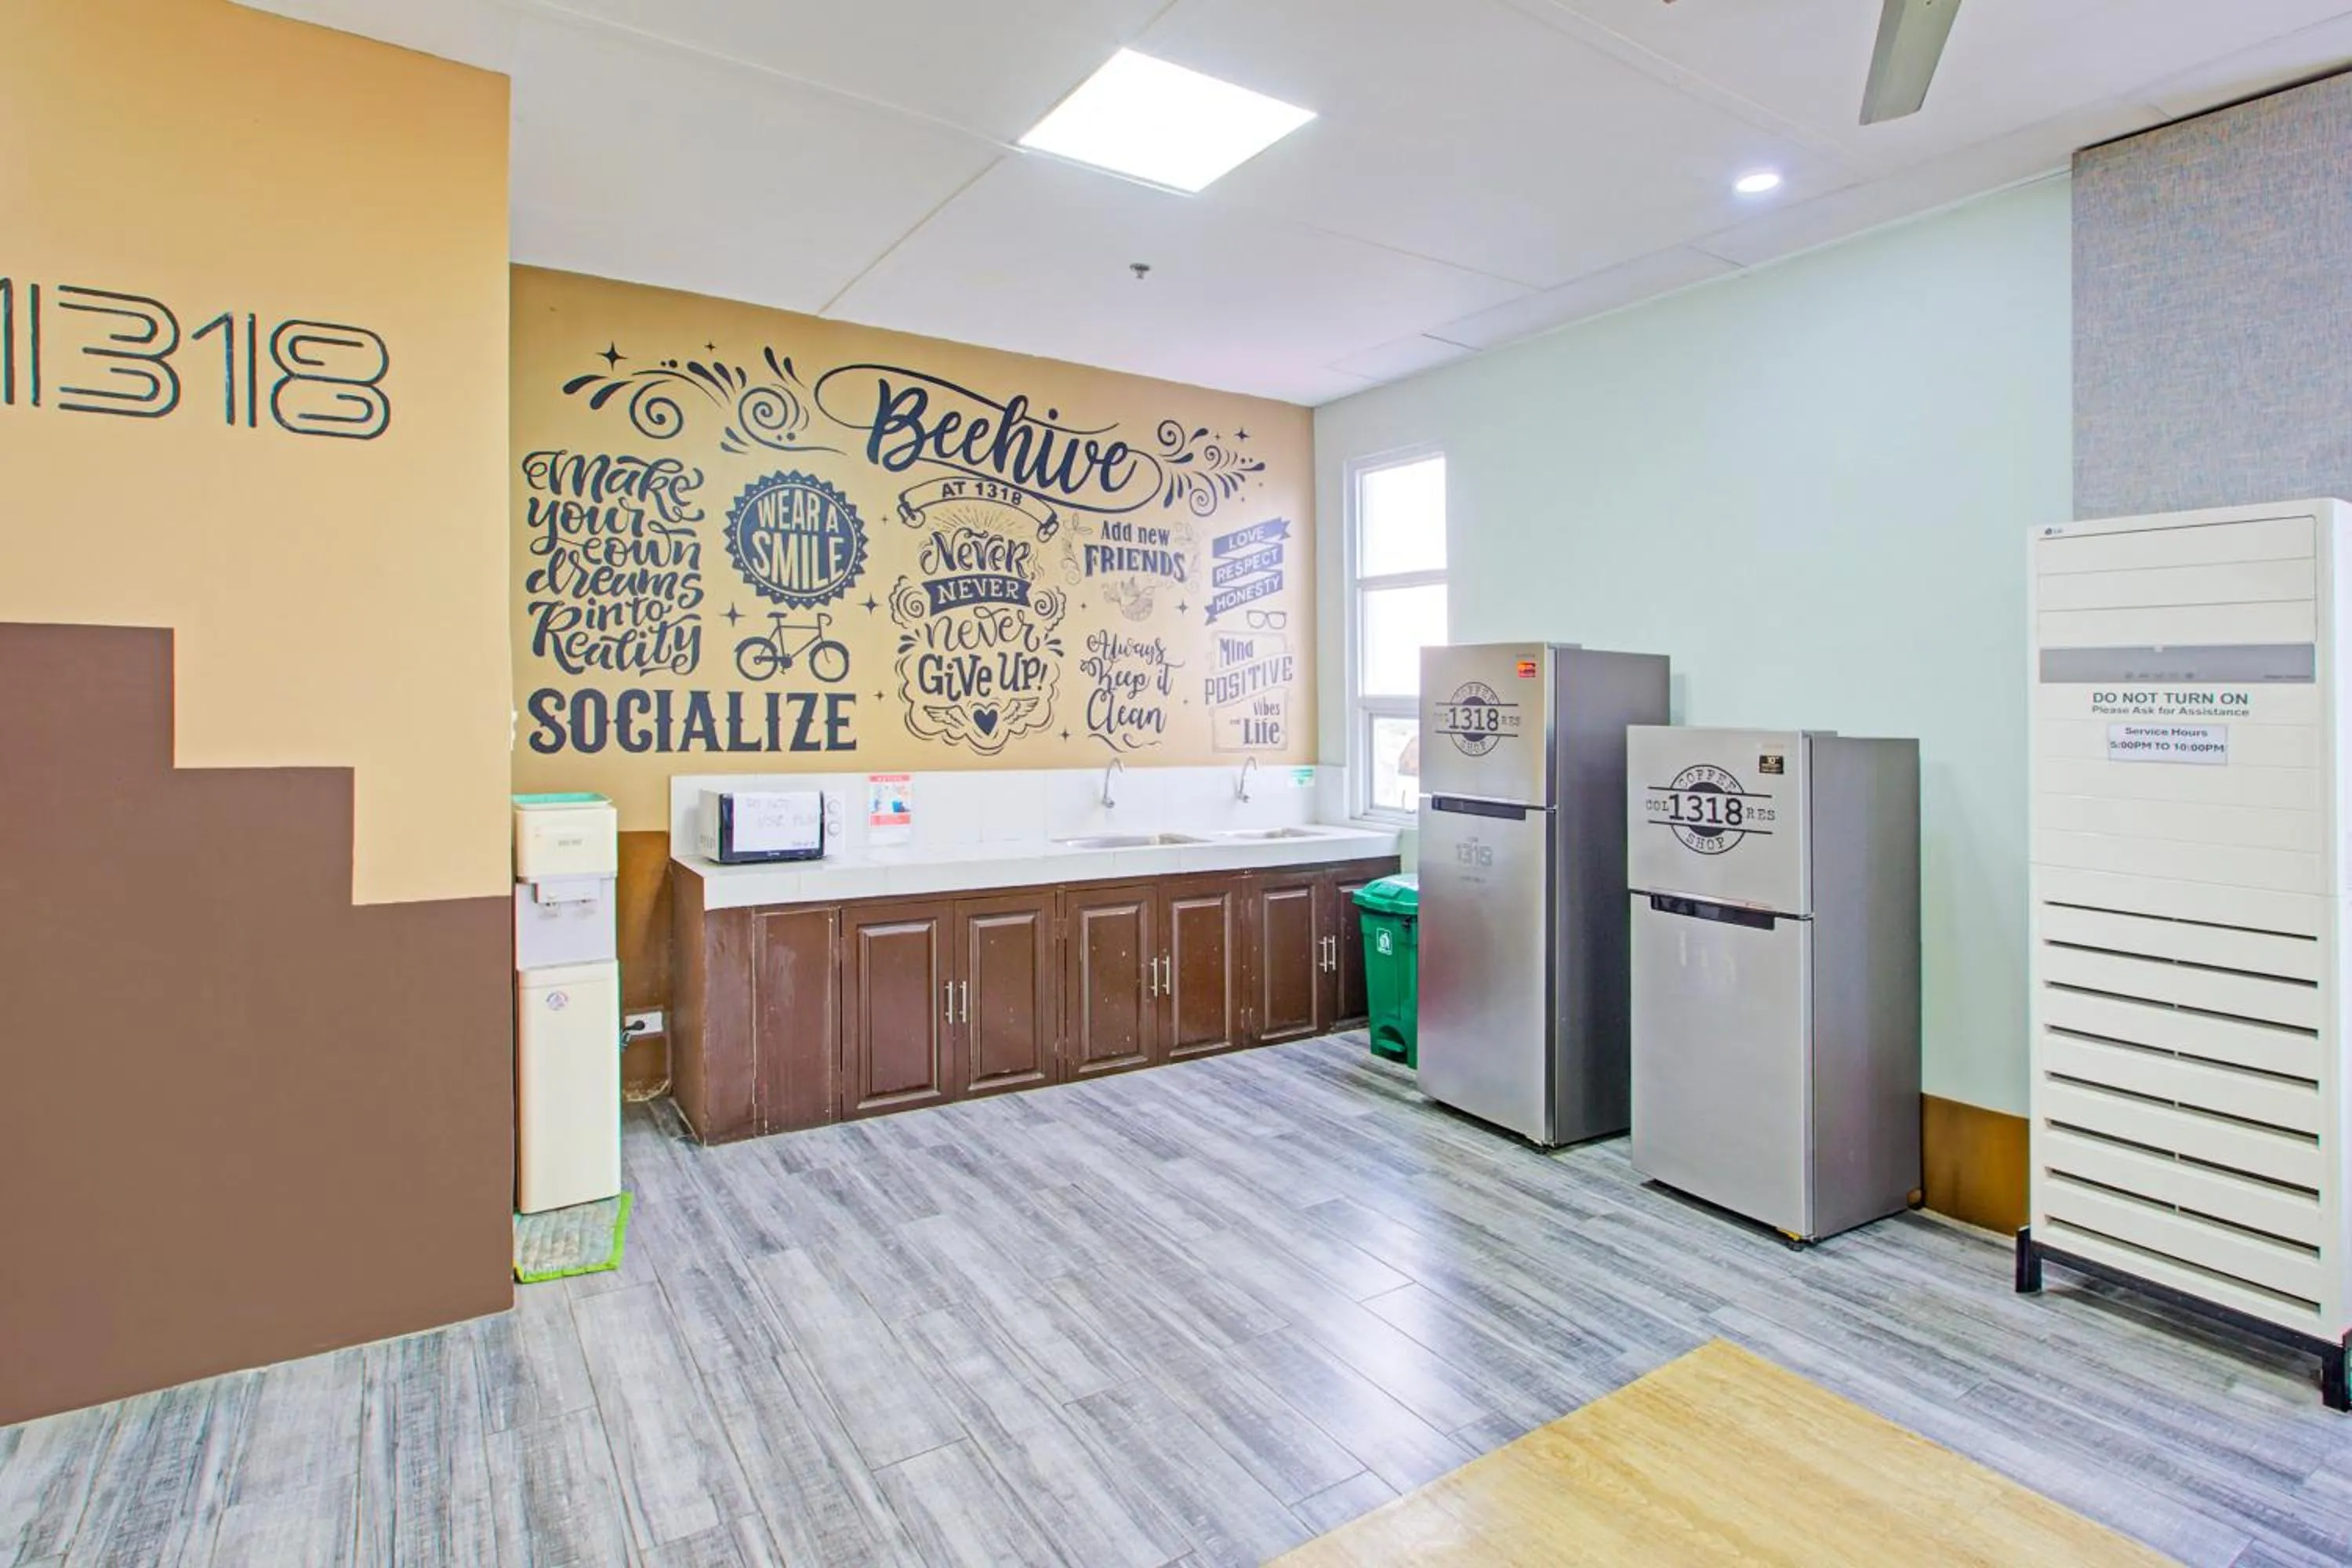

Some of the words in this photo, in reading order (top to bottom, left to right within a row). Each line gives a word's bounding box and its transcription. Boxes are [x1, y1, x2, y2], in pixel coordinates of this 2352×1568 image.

[866, 379, 1137, 494] Beehive
[522, 449, 704, 522] Make
[942, 481, 966, 498] AT
[975, 482, 1022, 506] 1318
[528, 496, 644, 555] your
[757, 489, 819, 531] WEAR
[826, 504, 840, 532] A
[583, 521, 700, 570] own
[1101, 520, 1131, 543] Add
[1138, 526, 1170, 546] new
[1228, 525, 1265, 550] LOVE
[526, 547, 704, 609] dreams
[751, 530, 845, 593] SMILE
[1083, 543, 1187, 583] FRIENDS
[1215, 548, 1279, 584] RESPECT
[937, 577, 1019, 604] NEVER
[1216, 575, 1280, 612] HONESTY
[586, 597, 672, 630] into
[924, 606, 1040, 652] never
[528, 601, 702, 677] Reality
[1087, 629, 1167, 665] Always
[1080, 657, 1150, 700] Keep
[1156, 662, 1174, 696] it
[1204, 655, 1293, 705] POSITIVE
[1087, 688, 1167, 735] Clean
[2092, 692, 2117, 703] DO
[2122, 692, 2158, 703] NOT
[2163, 692, 2214, 704] TURN
[2220, 692, 2249, 705] ON
[2092, 706, 2129, 714] Please
[2132, 706, 2154, 714] Ask
[2158, 706, 2176, 715] for
[2178, 706, 2249, 717] Assistance
[528, 688, 857, 753] SOCIALIZE
[1243, 717, 1280, 745] Life
[1449, 707, 1499, 731] 1318
[2125, 727, 2168, 736] Service
[2171, 728, 2208, 737] Hours
[2110, 741, 2152, 750] 5:00PM
[2155, 742, 2170, 750] TO
[2174, 743, 2224, 753] 10:00PM
[1679, 769, 1737, 793] COFFEE
[1646, 799, 1669, 811] COL
[1668, 793, 1743, 826] 1318
[1746, 807, 1776, 821] RES
[1686, 833, 1725, 850] SHOP
